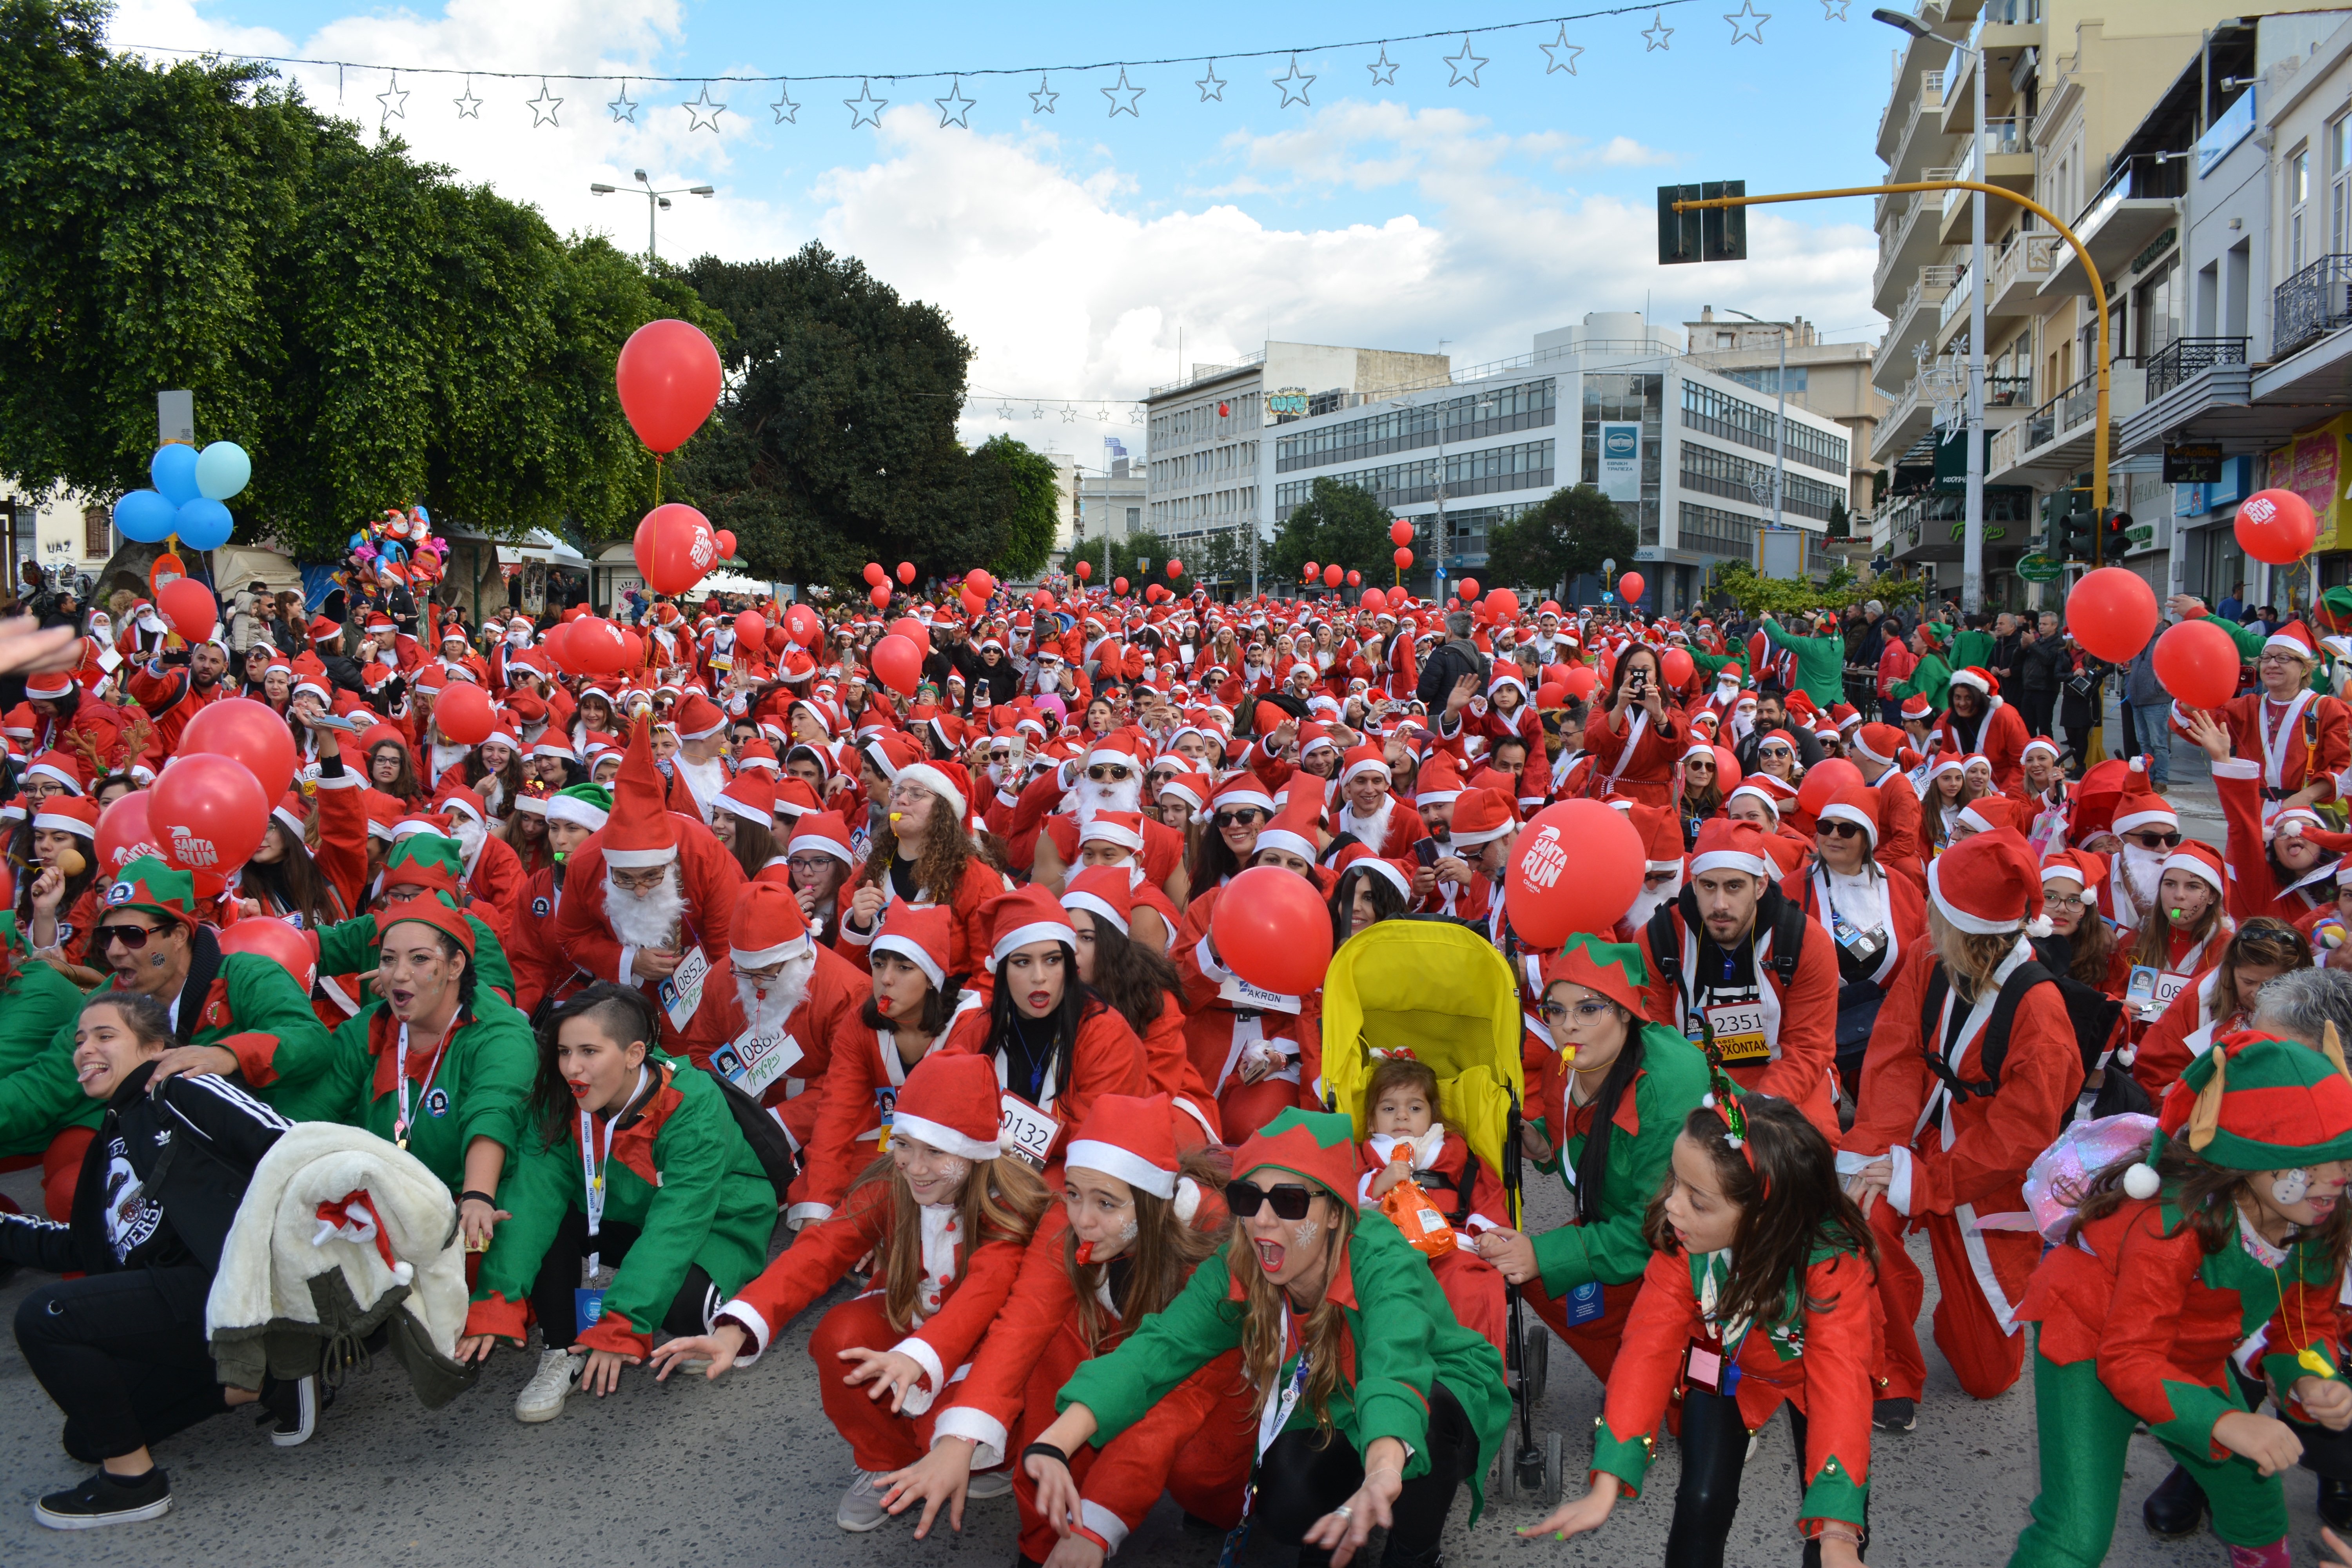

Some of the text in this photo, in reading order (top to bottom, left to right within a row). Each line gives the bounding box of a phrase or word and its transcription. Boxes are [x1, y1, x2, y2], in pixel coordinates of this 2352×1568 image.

[2247, 498, 2270, 517] SANTA
[2250, 502, 2276, 525] RUN
[695, 535, 713, 555] SANTA
[690, 544, 712, 568] RUN
[124, 842, 151, 866] ANTA
[174, 838, 215, 851] SANTA
[1532, 838, 1568, 869] SANTA
[176, 849, 219, 866] RUN
[1521, 850, 1563, 887] RUN
[1523, 879, 1541, 894] CHANIA
[152, 957, 165, 966] RUN
[678, 957, 705, 991] 0852
[1248, 990, 1281, 1003] AKRON
[1715, 1013, 1763, 1033] 2351
[724, 1061, 734, 1070] RUN
